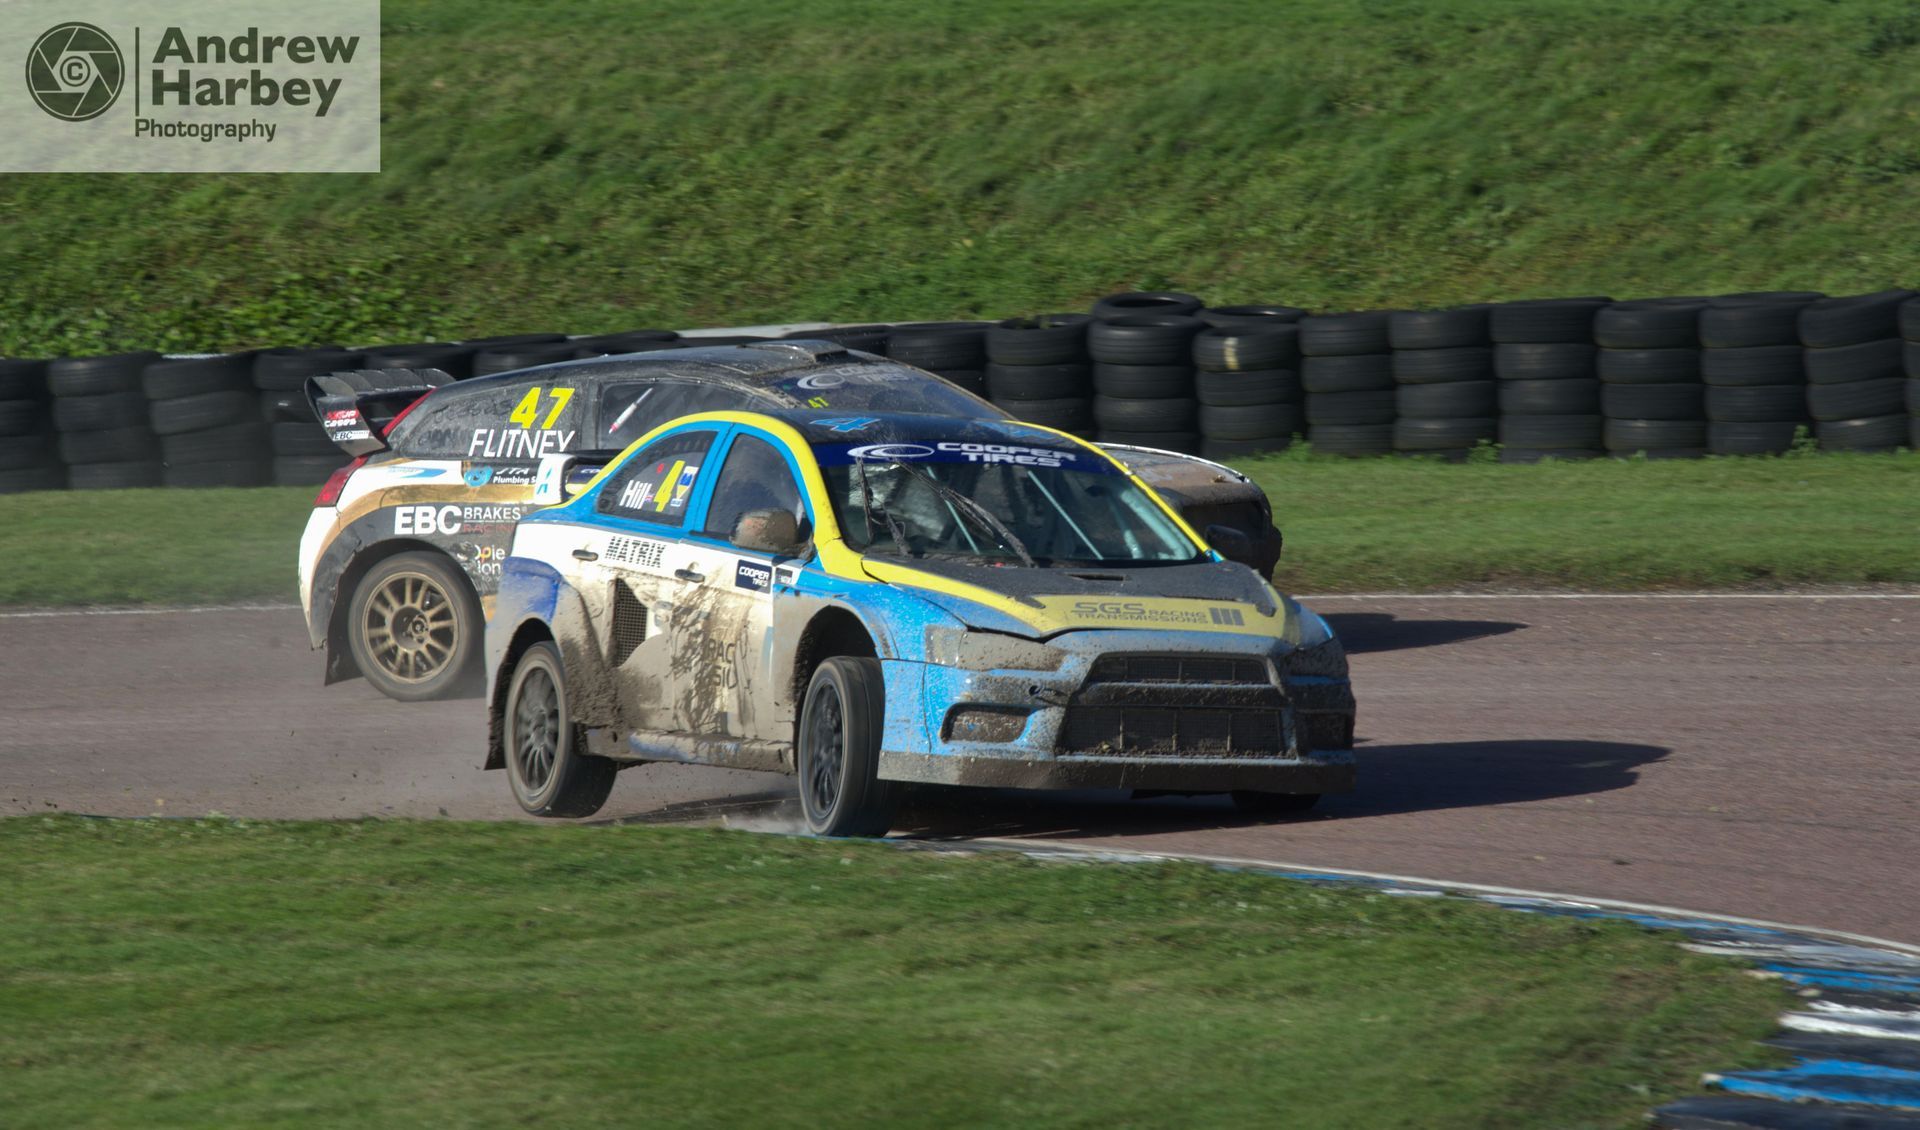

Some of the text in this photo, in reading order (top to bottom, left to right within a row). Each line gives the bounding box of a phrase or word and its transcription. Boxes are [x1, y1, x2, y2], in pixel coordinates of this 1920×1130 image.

[509, 387, 575, 430] 47
[807, 396, 829, 408] 47
[468, 428, 576, 459] FLITNEY
[937, 442, 1077, 462] COOPER
[961, 452, 1062, 467] TIRES
[493, 475, 530, 485] Plumbing
[654, 460, 686, 513] 4
[619, 480, 652, 510] Hill
[394, 505, 521, 535] EBC BRAKES
[604, 536, 667, 568] MATRIX
[739, 566, 770, 580] COOPER
[1071, 602, 1207, 618] SGS RACING
[1077, 613, 1209, 624] TRANSMISSIONS
